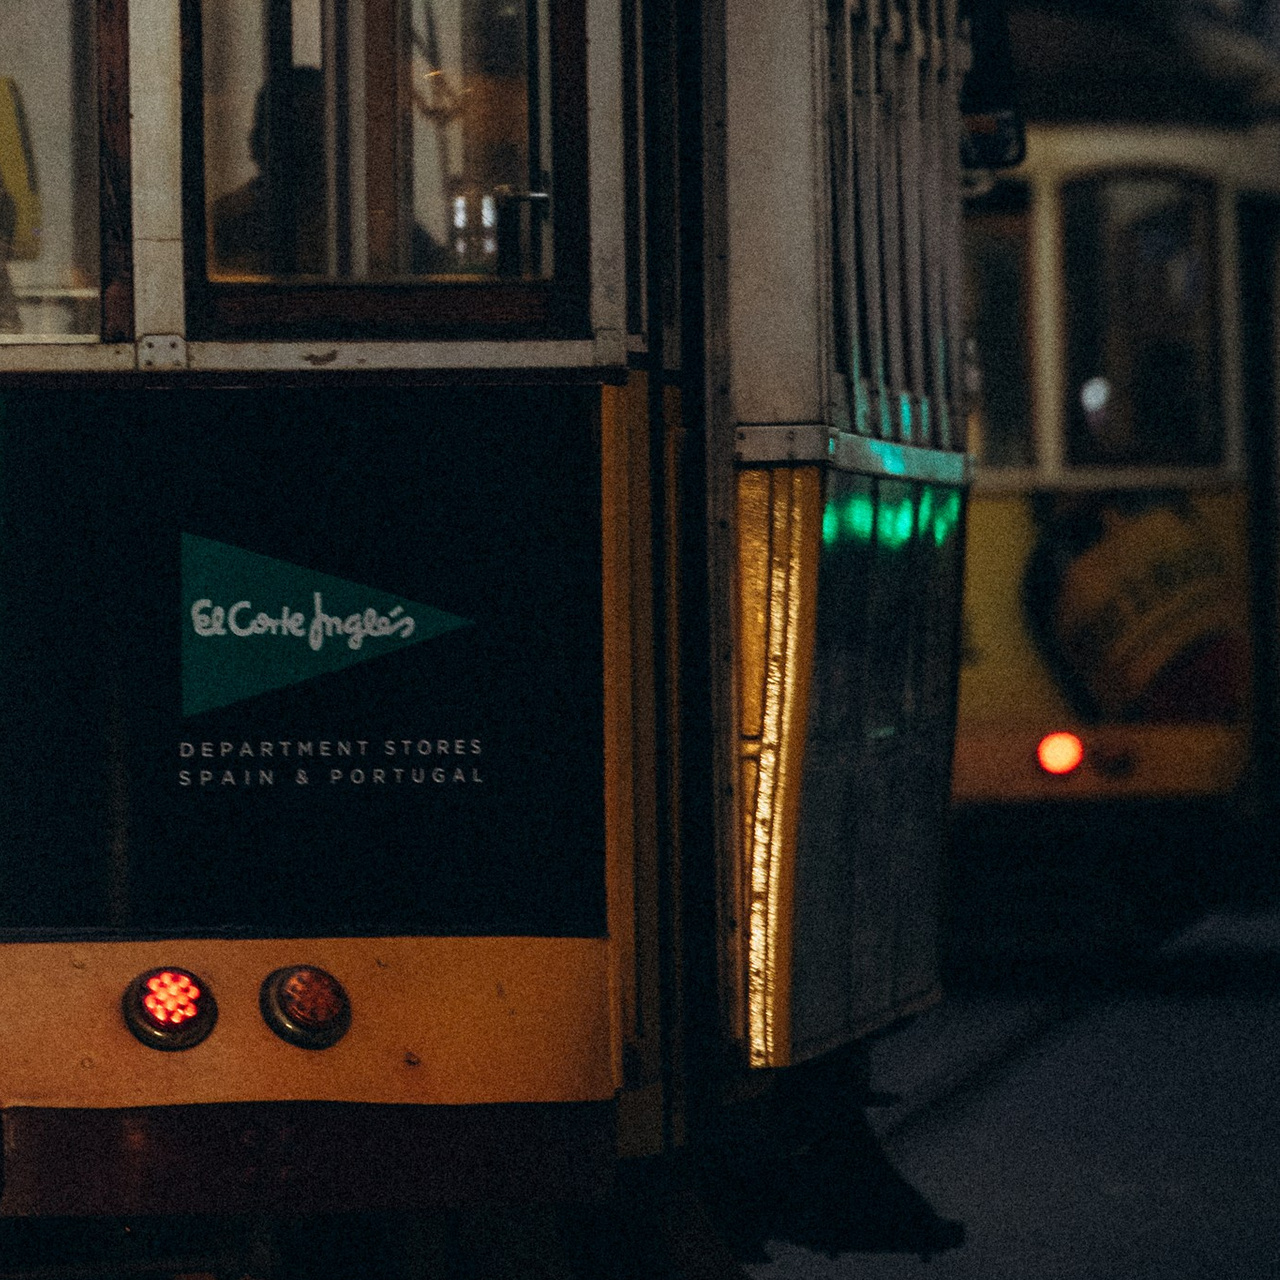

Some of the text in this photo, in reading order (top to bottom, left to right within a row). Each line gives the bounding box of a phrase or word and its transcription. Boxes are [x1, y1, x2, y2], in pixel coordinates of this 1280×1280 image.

[191, 591, 416, 651] El Corte Inglés
[178, 738, 483, 759] DEPARTMENT STORES
[178, 767, 484, 787] SPAIN & PORTUGAL
